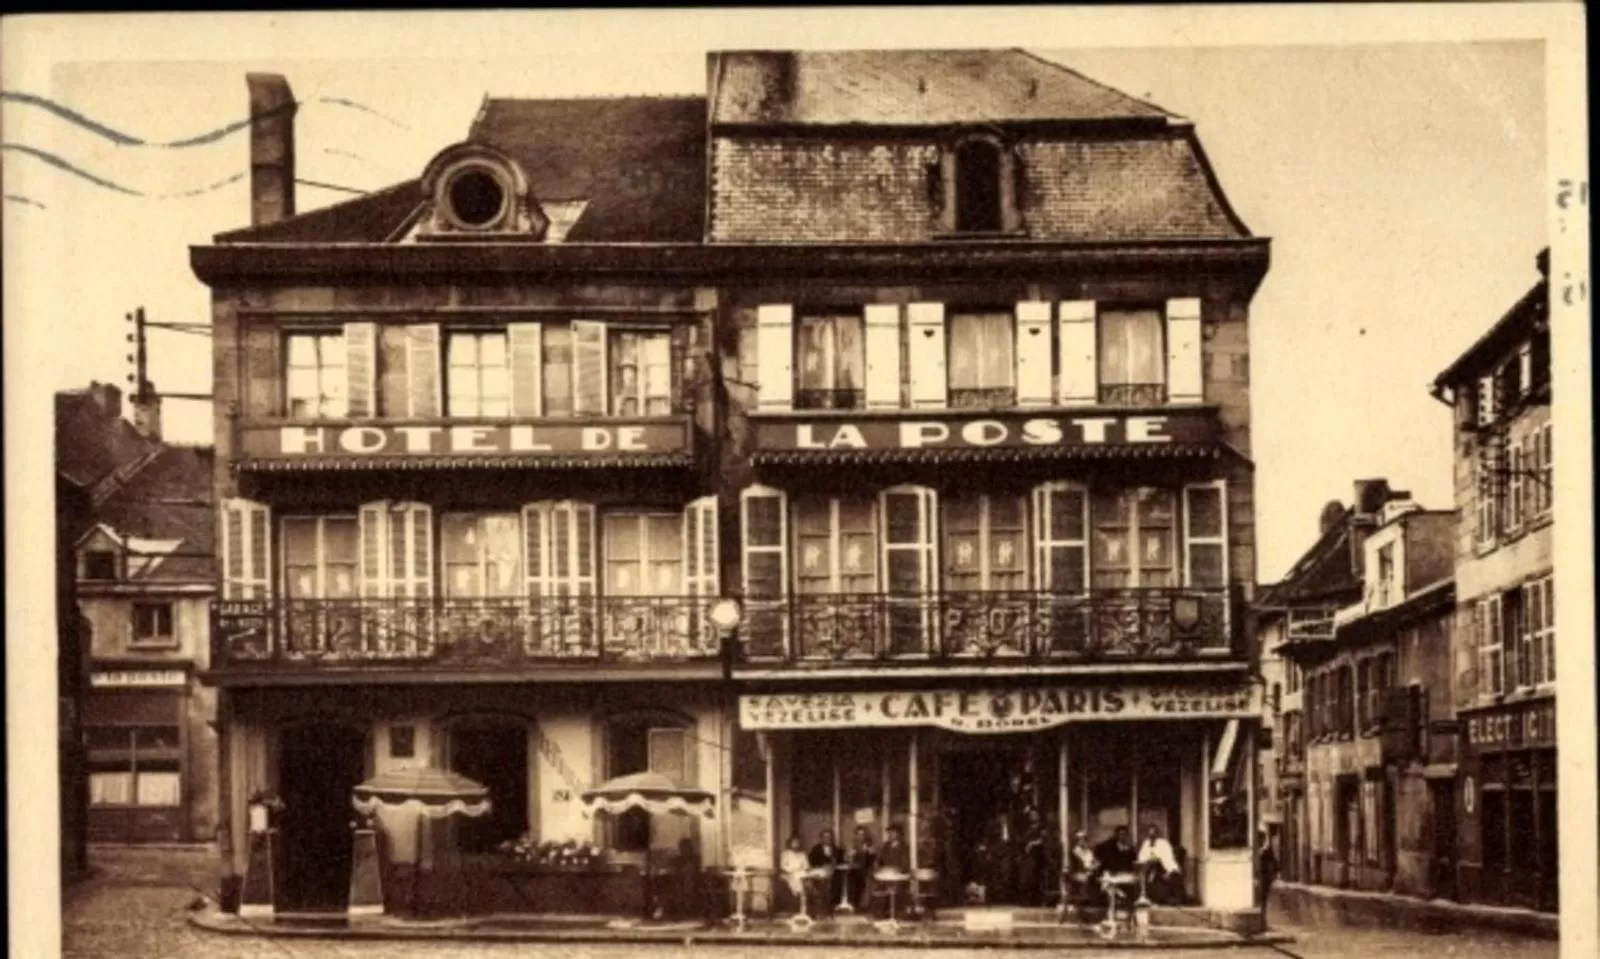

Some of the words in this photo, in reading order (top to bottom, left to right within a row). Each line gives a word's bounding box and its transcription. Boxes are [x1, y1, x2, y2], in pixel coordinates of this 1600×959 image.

[280, 425, 552, 454] HOTEL
[581, 426, 648, 451] DE
[796, 423, 869, 450] LA
[900, 416, 1174, 448] POSTE
[1019, 689, 1125, 715] PARIS
